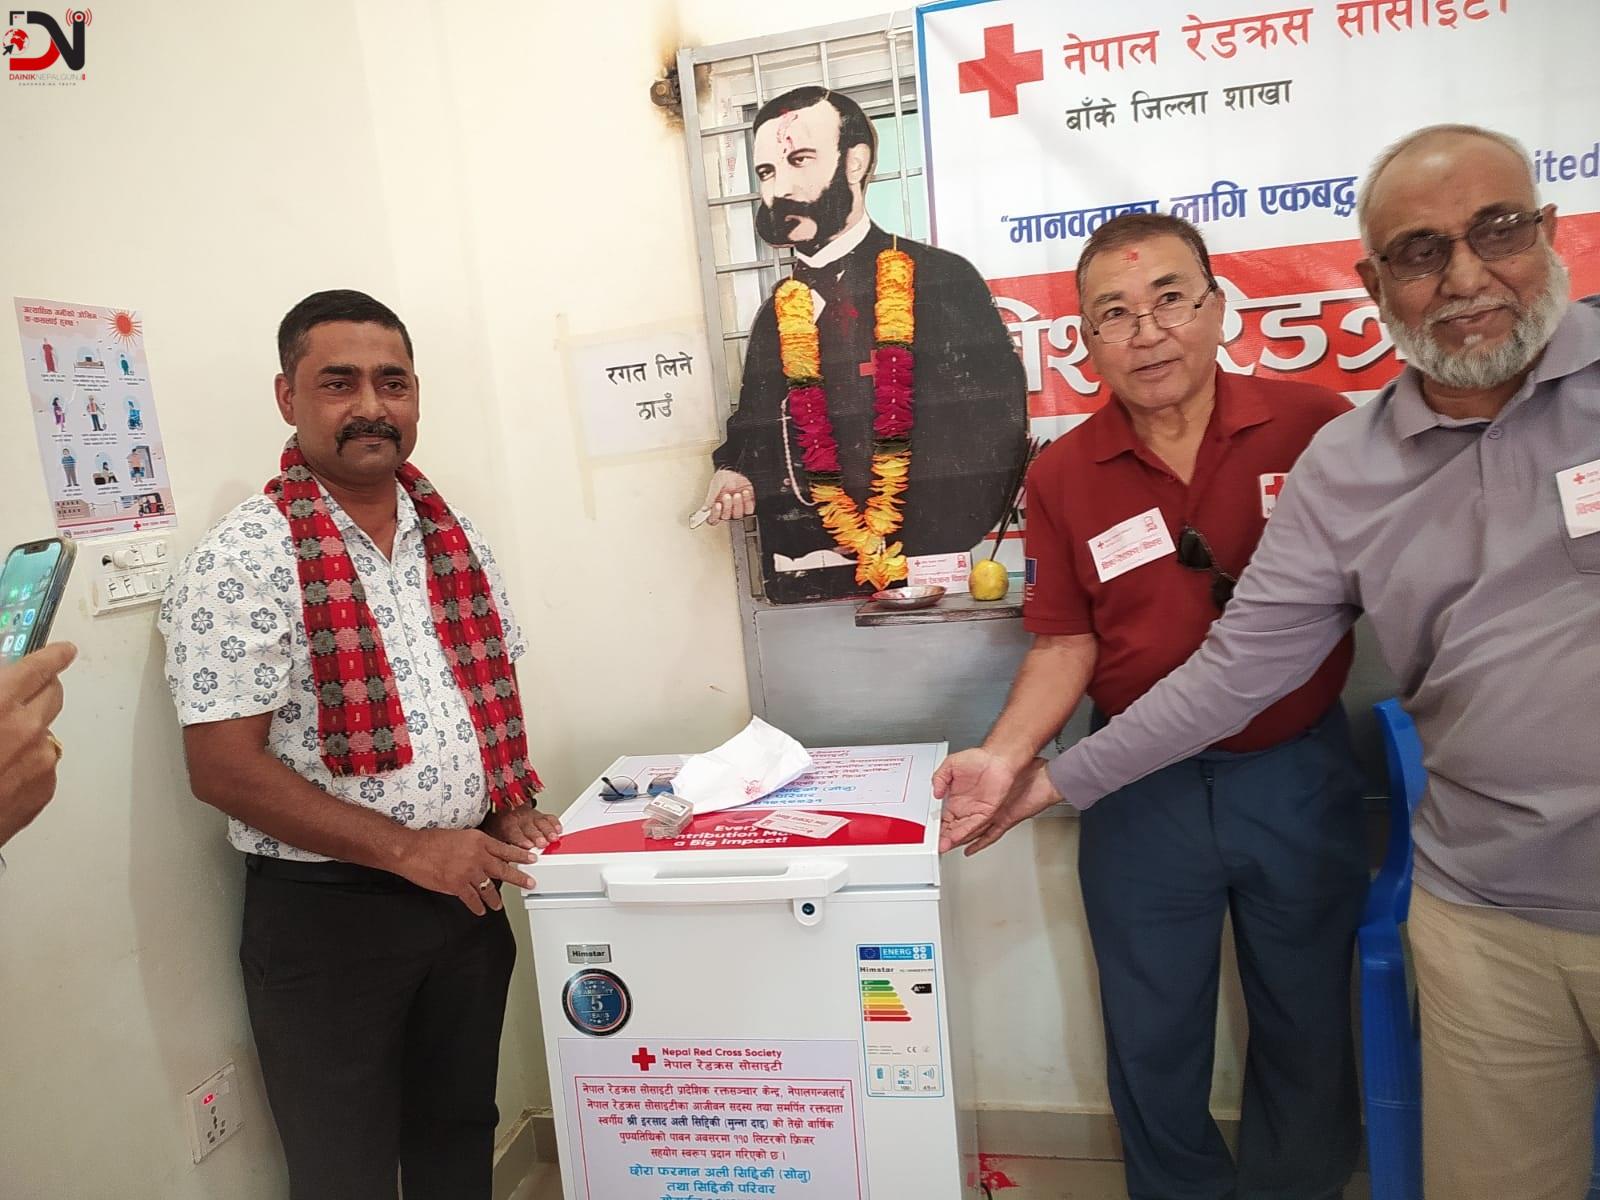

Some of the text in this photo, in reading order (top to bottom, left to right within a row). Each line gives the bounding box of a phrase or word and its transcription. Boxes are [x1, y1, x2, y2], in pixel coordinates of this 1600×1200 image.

[1063, 30, 1160, 75] नेपाल
[1182, 8, 1314, 61] रेडक्रस
[1065, 79, 1293, 131] बाँके जिल्ला शाखा
[1535, 143, 1600, 184] ited
[1169, 180, 1248, 224] लागि
[1259, 176, 1359, 218] एकबद्ध
[605, 351, 693, 385] रगत लिने
[636, 392, 673, 420] ठाउँ
[675, 831, 758, 839] ntribution
[714, 825, 758, 833] Every
[721, 837, 788, 846] Impact!
[592, 995, 603, 1011] 5
[662, 1048, 782, 1058] Nepal Red Cross Society
[664, 1059, 783, 1071] नेपाल रेडक्रस सोसाइटी
[582, 1082, 604, 1094] नेपाल
[607, 1082, 636, 1095] रेडक्रस
[640, 1083, 673, 1096] सोसाइटी
[677, 1083, 709, 1095] प्रादेशिक
[587, 1098, 843, 1114] नेपाल रेडक्रस सोसाइटीका आजीवन सदस्य तथा समर्पित रक्तदाता
[627, 1114, 637, 1126] श्री
[641, 1117, 667, 1127] इरसाद
[671, 1115, 688, 1126] अली
[725, 1118, 747, 1130] (मुन्ना
[773, 1117, 784, 1128] को
[670, 1133, 690, 1142] पावन
[695, 1133, 729, 1143] अवसरमा
[753, 1132, 785, 1144] लिटरको
[651, 1146, 677, 1158] सहयोग
[710, 1149, 731, 1159] प्रदान
[735, 1147, 766, 1161] गरिएको
[770, 1151, 779, 1160] छ
[629, 1163, 653, 1176] छोरा
[657, 1166, 700, 1176] फरमान
[705, 1165, 729, 1177] अली
[779, 1167, 811, 1183] (सोनु)
[666, 1182, 690, 1192] तथा
[738, 1181, 776, 1194] परिवार
